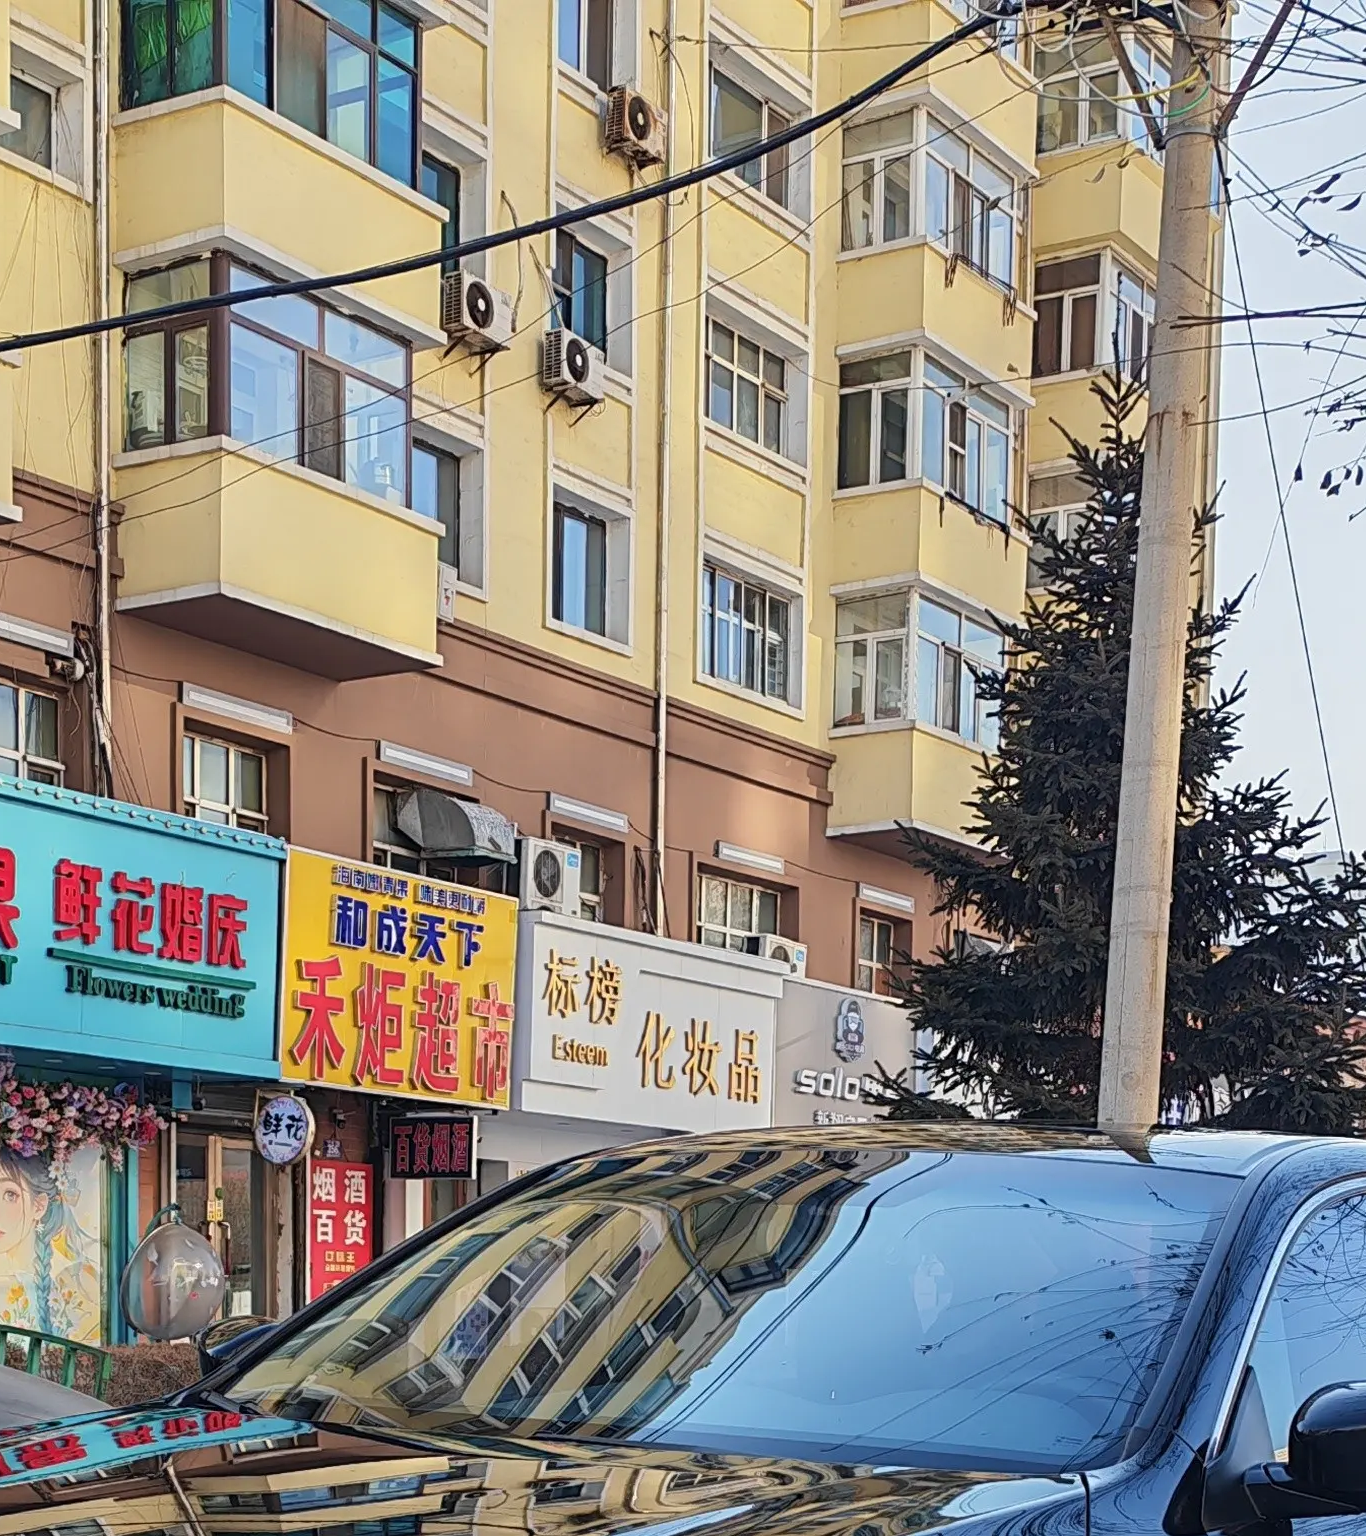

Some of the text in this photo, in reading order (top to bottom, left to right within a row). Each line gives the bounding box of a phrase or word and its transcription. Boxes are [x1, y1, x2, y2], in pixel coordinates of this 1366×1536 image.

[53, 858, 248, 969] 鲜花婚庆
[330, 894, 484, 969] 和成天下
[65, 965, 246, 1019] Flowers wedding
[542, 949, 622, 1025] 标榜
[291, 955, 514, 1100] 禾炬超市
[552, 1034, 609, 1067] Esteem
[635, 1011, 762, 1104] 化妆品
[263, 1112, 303, 1141] 鲜花
[394, 1122, 469, 1174] 百货烟酒
[312, 1166, 366, 1205] 烟酒
[312, 1209, 367, 1246] 百货
